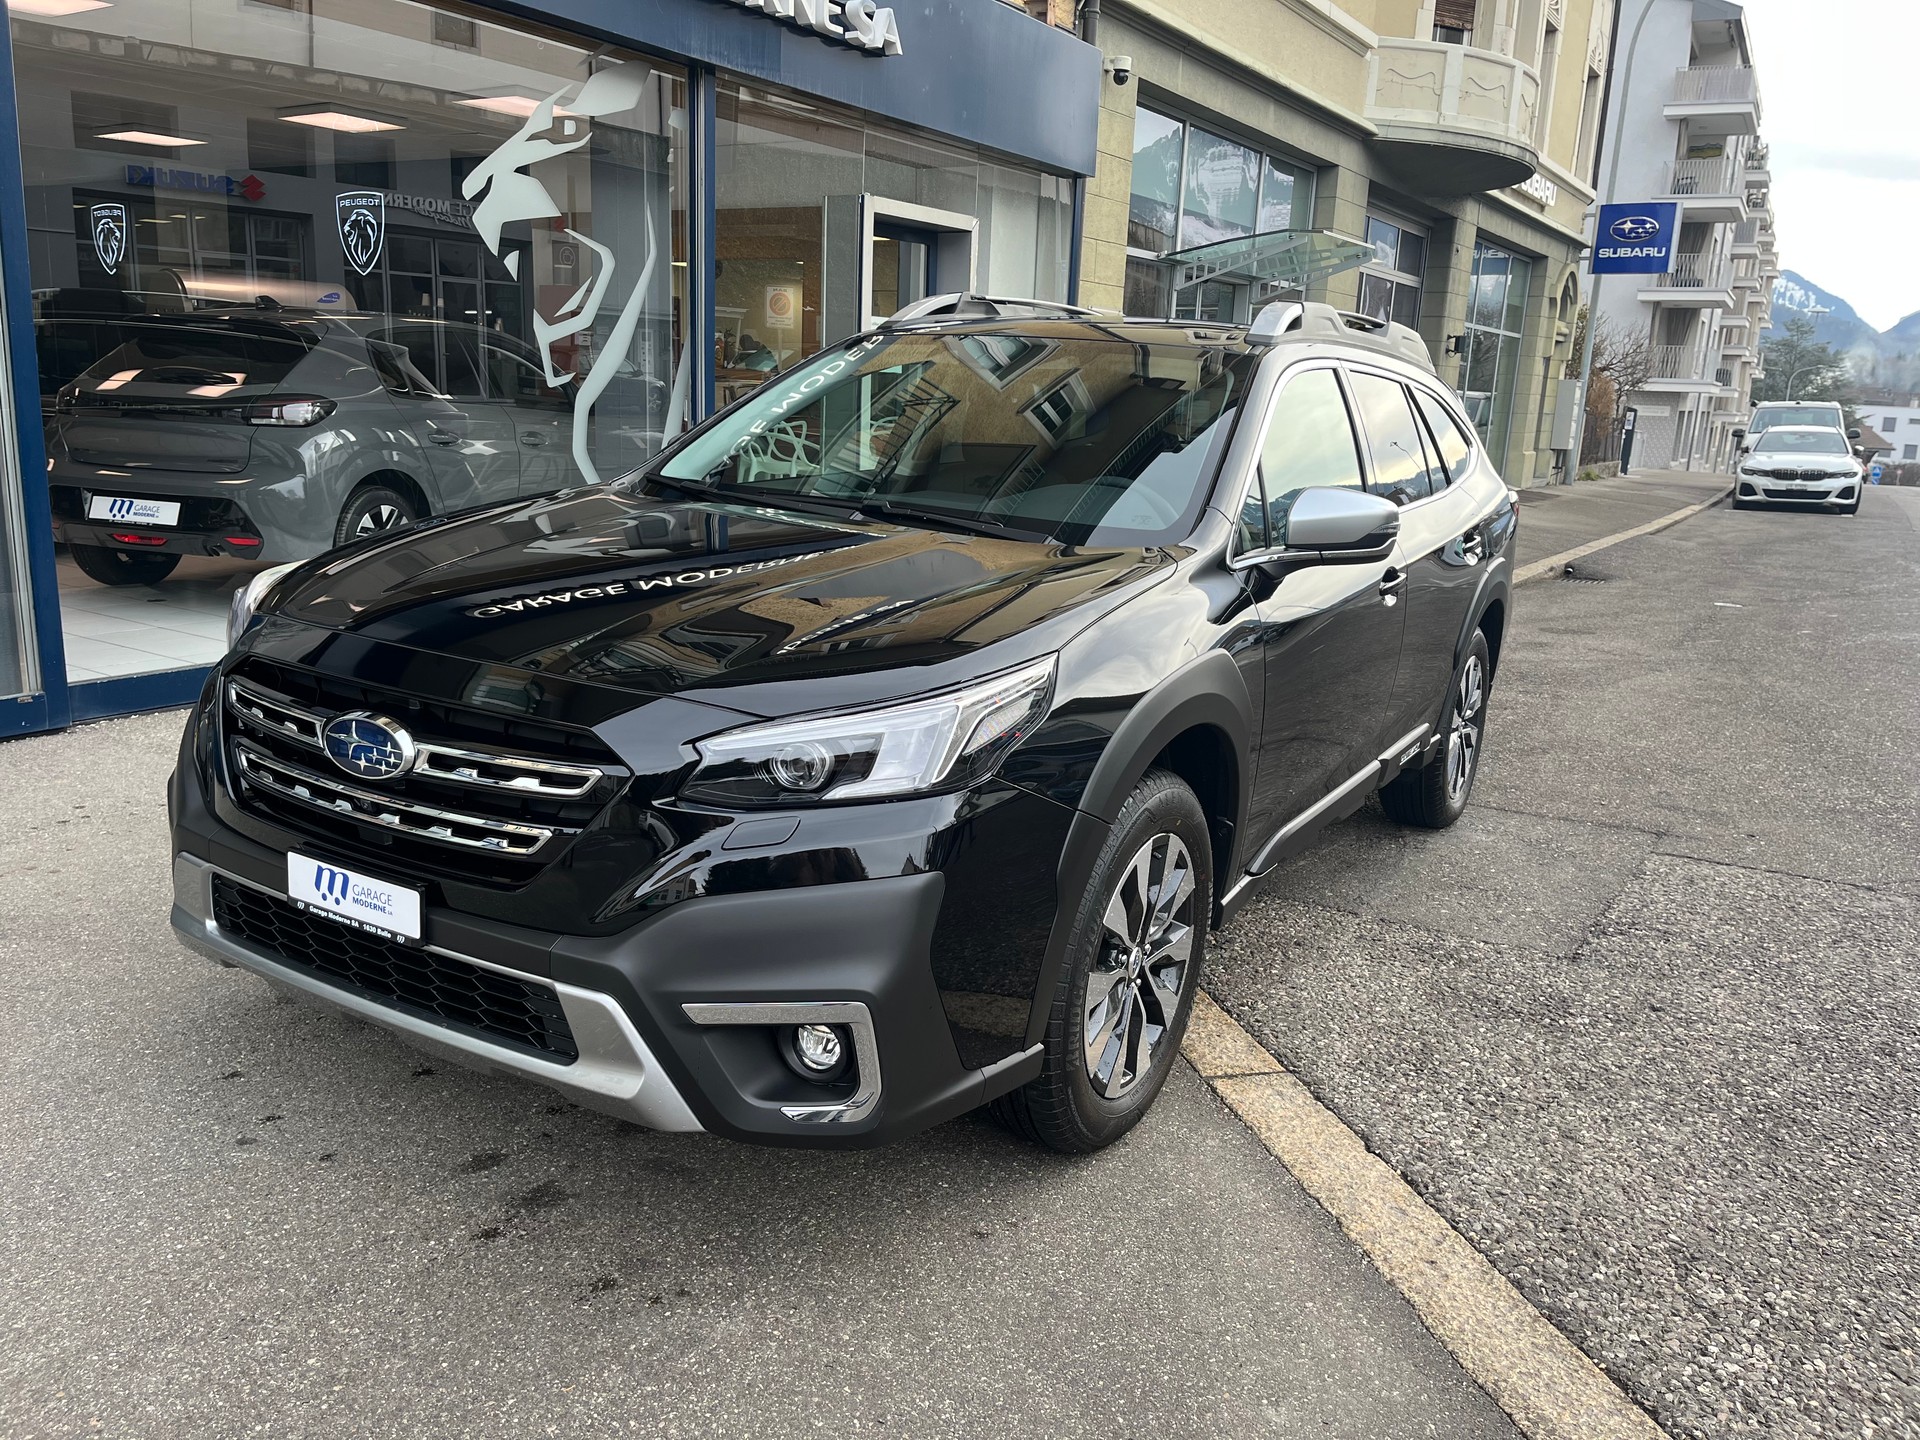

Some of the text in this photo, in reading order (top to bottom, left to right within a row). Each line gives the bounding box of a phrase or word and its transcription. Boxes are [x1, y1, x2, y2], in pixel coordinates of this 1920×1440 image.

[340, 198, 380, 207] PEUGEOT
[1598, 247, 1666, 258] SUBARU
[134, 504, 160, 514] GARAGE
[352, 884, 393, 907] GARAGE
[352, 897, 387, 915] MODERNE
[309, 905, 328, 917] Garage
[328, 911, 351, 925] Moderne
[351, 919, 359, 928] SA
[376, 928, 392, 939] Bulle
